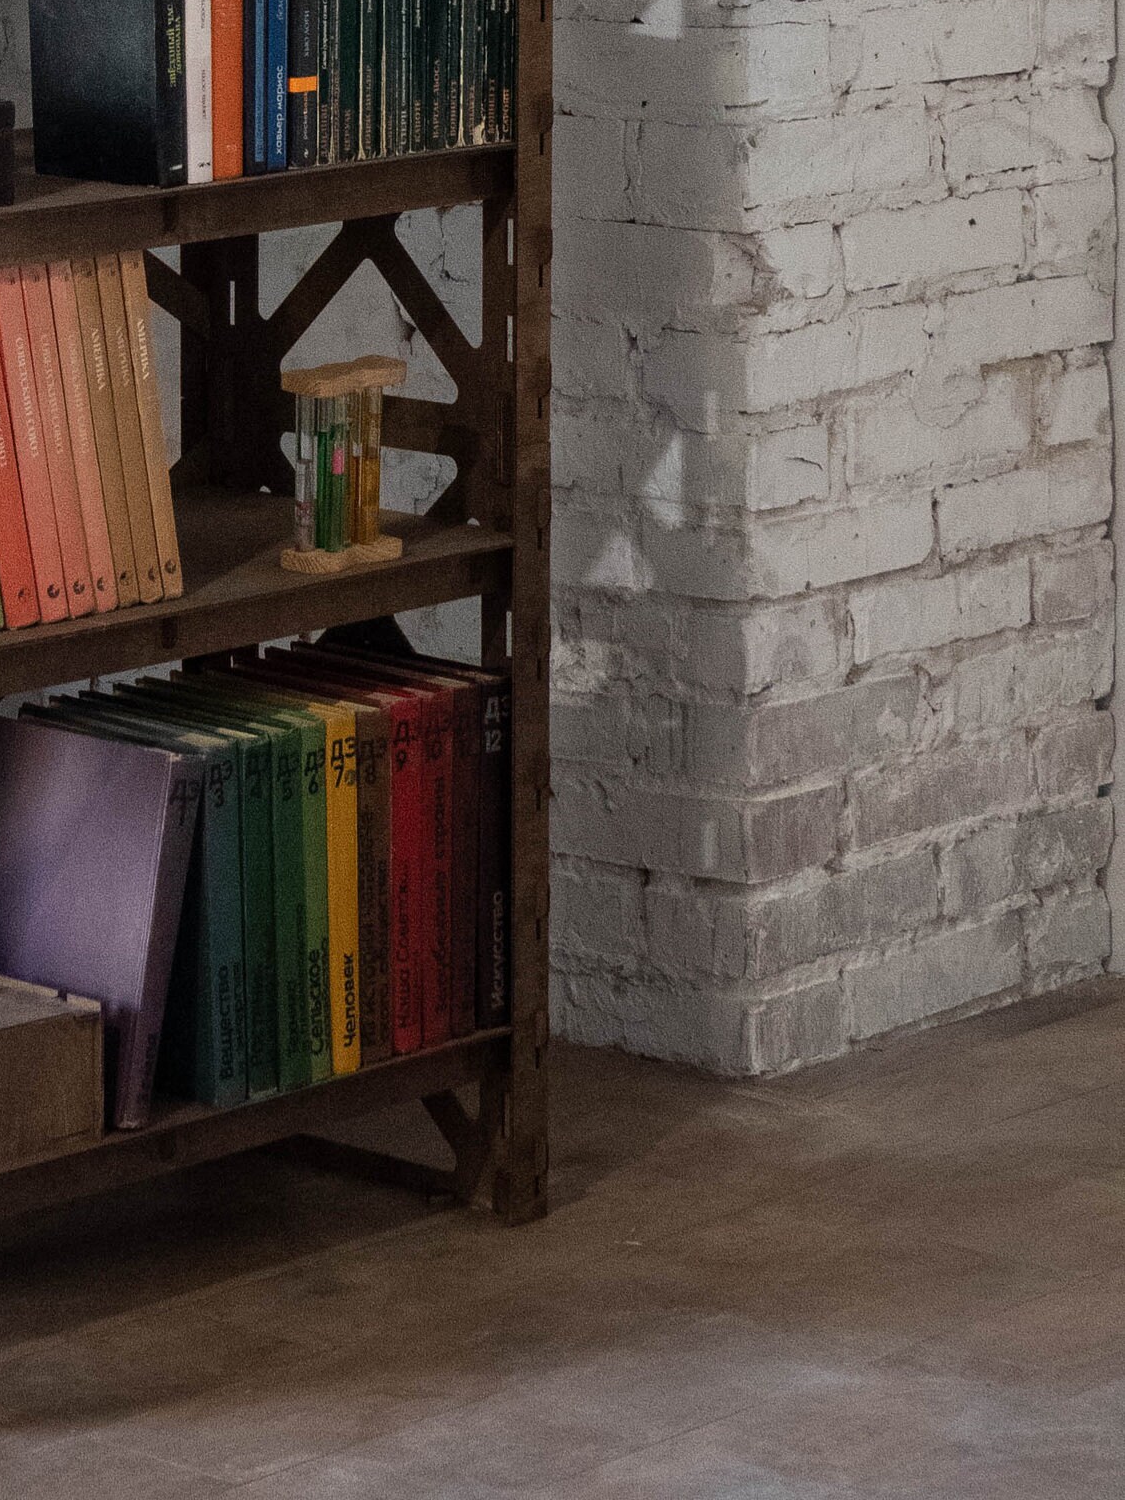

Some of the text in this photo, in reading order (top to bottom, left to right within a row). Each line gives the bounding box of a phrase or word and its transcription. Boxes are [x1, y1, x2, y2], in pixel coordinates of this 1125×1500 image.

[275, 64, 284, 156] хавьер мариас
[432, 58, 441, 139] ВАРГАС ЛЬОСА
[90, 327, 107, 391] АМЕРИКА
[115, 325, 130, 387] АМЕРИКА
[136, 317, 150, 381] АМЕРИКА
[15, 336, 39, 458] СОВЕТСКИЙ СОЮЗ
[51, 417, 63, 456] СОЮЗ
[304, 750, 325, 777] ДЭ
[330, 737, 357, 762] ДЭ
[396, 749, 408, 772] 9
[485, 729, 502, 754] 12
[308, 773, 319, 794] 6
[334, 766, 345, 788] 7
[491, 890, 505, 1011] Искусство
[218, 965, 233, 1080] Вещество
[308, 949, 324, 1056] Сельское
[343, 952, 356, 1048] Человек
